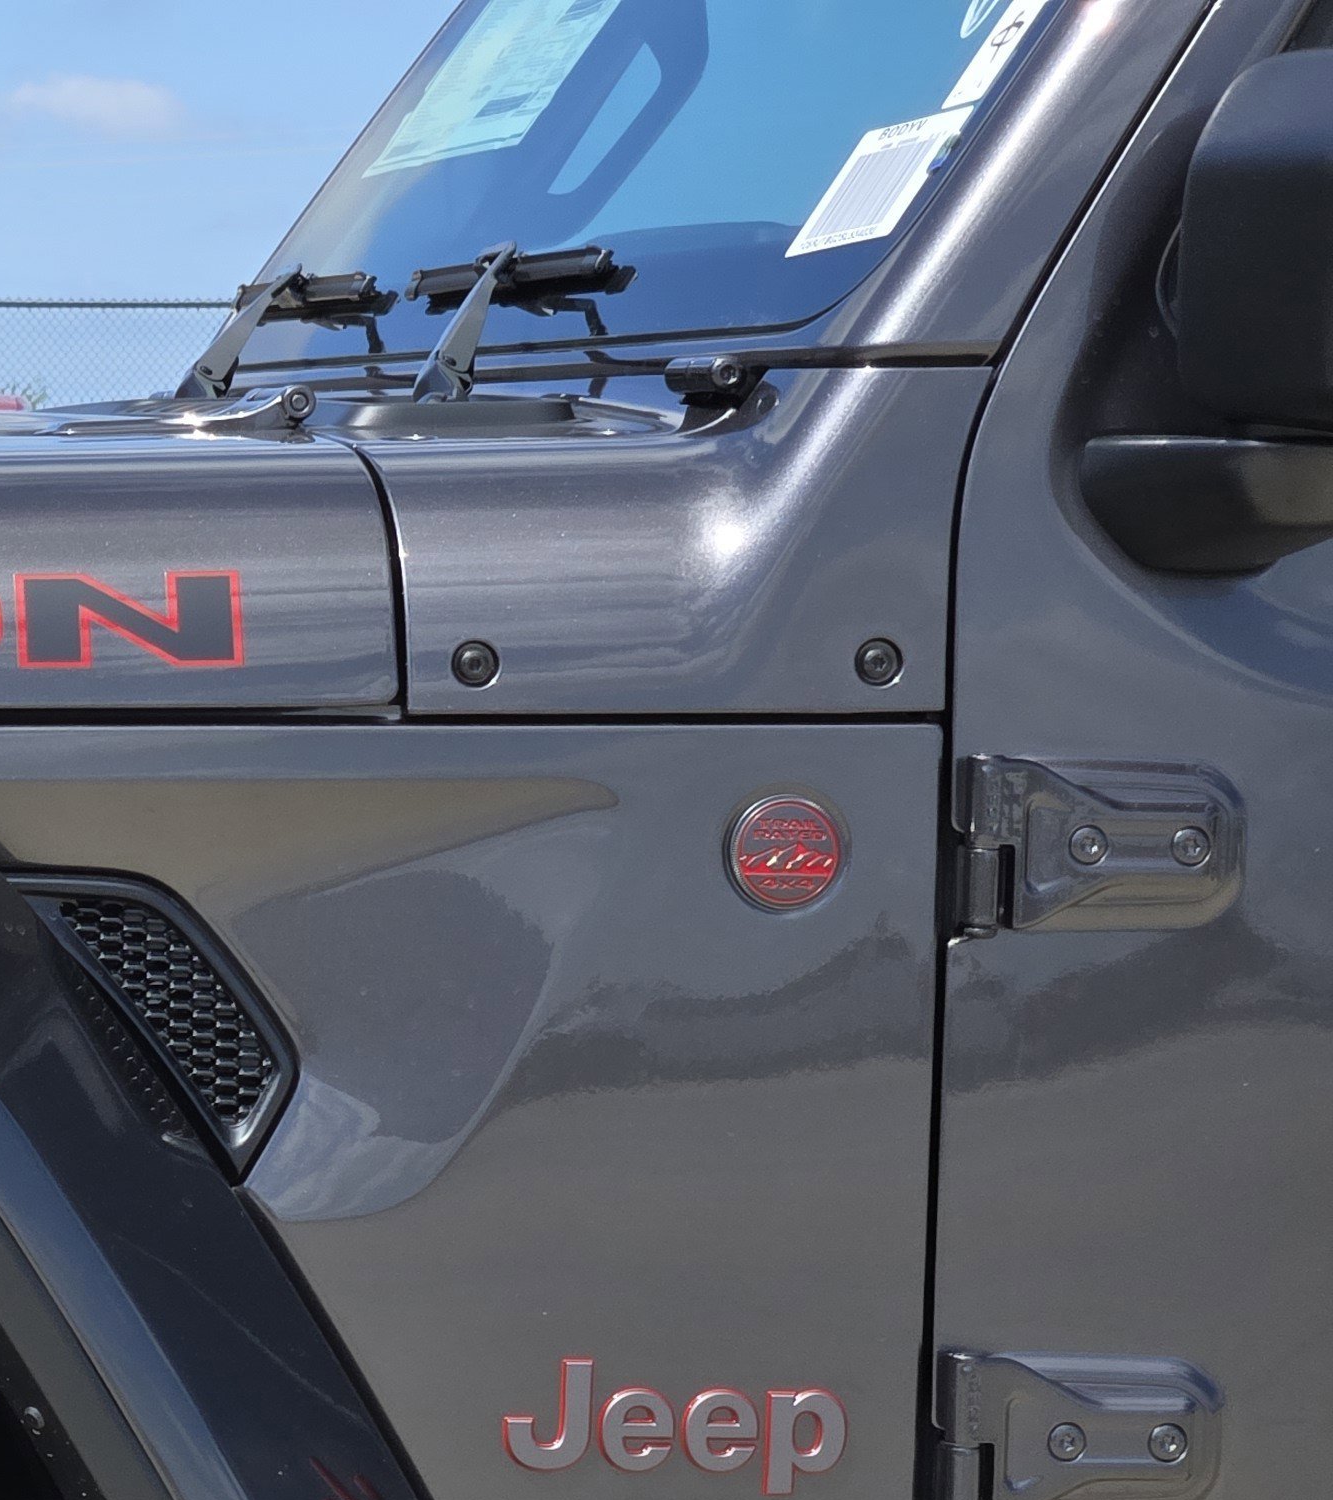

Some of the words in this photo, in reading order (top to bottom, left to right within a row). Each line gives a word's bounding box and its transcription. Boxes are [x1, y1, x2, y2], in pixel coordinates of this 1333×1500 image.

[758, 818, 821, 830] TRAIL
[753, 829, 828, 841] RATED
[501, 1355, 848, 1497] Jeep
